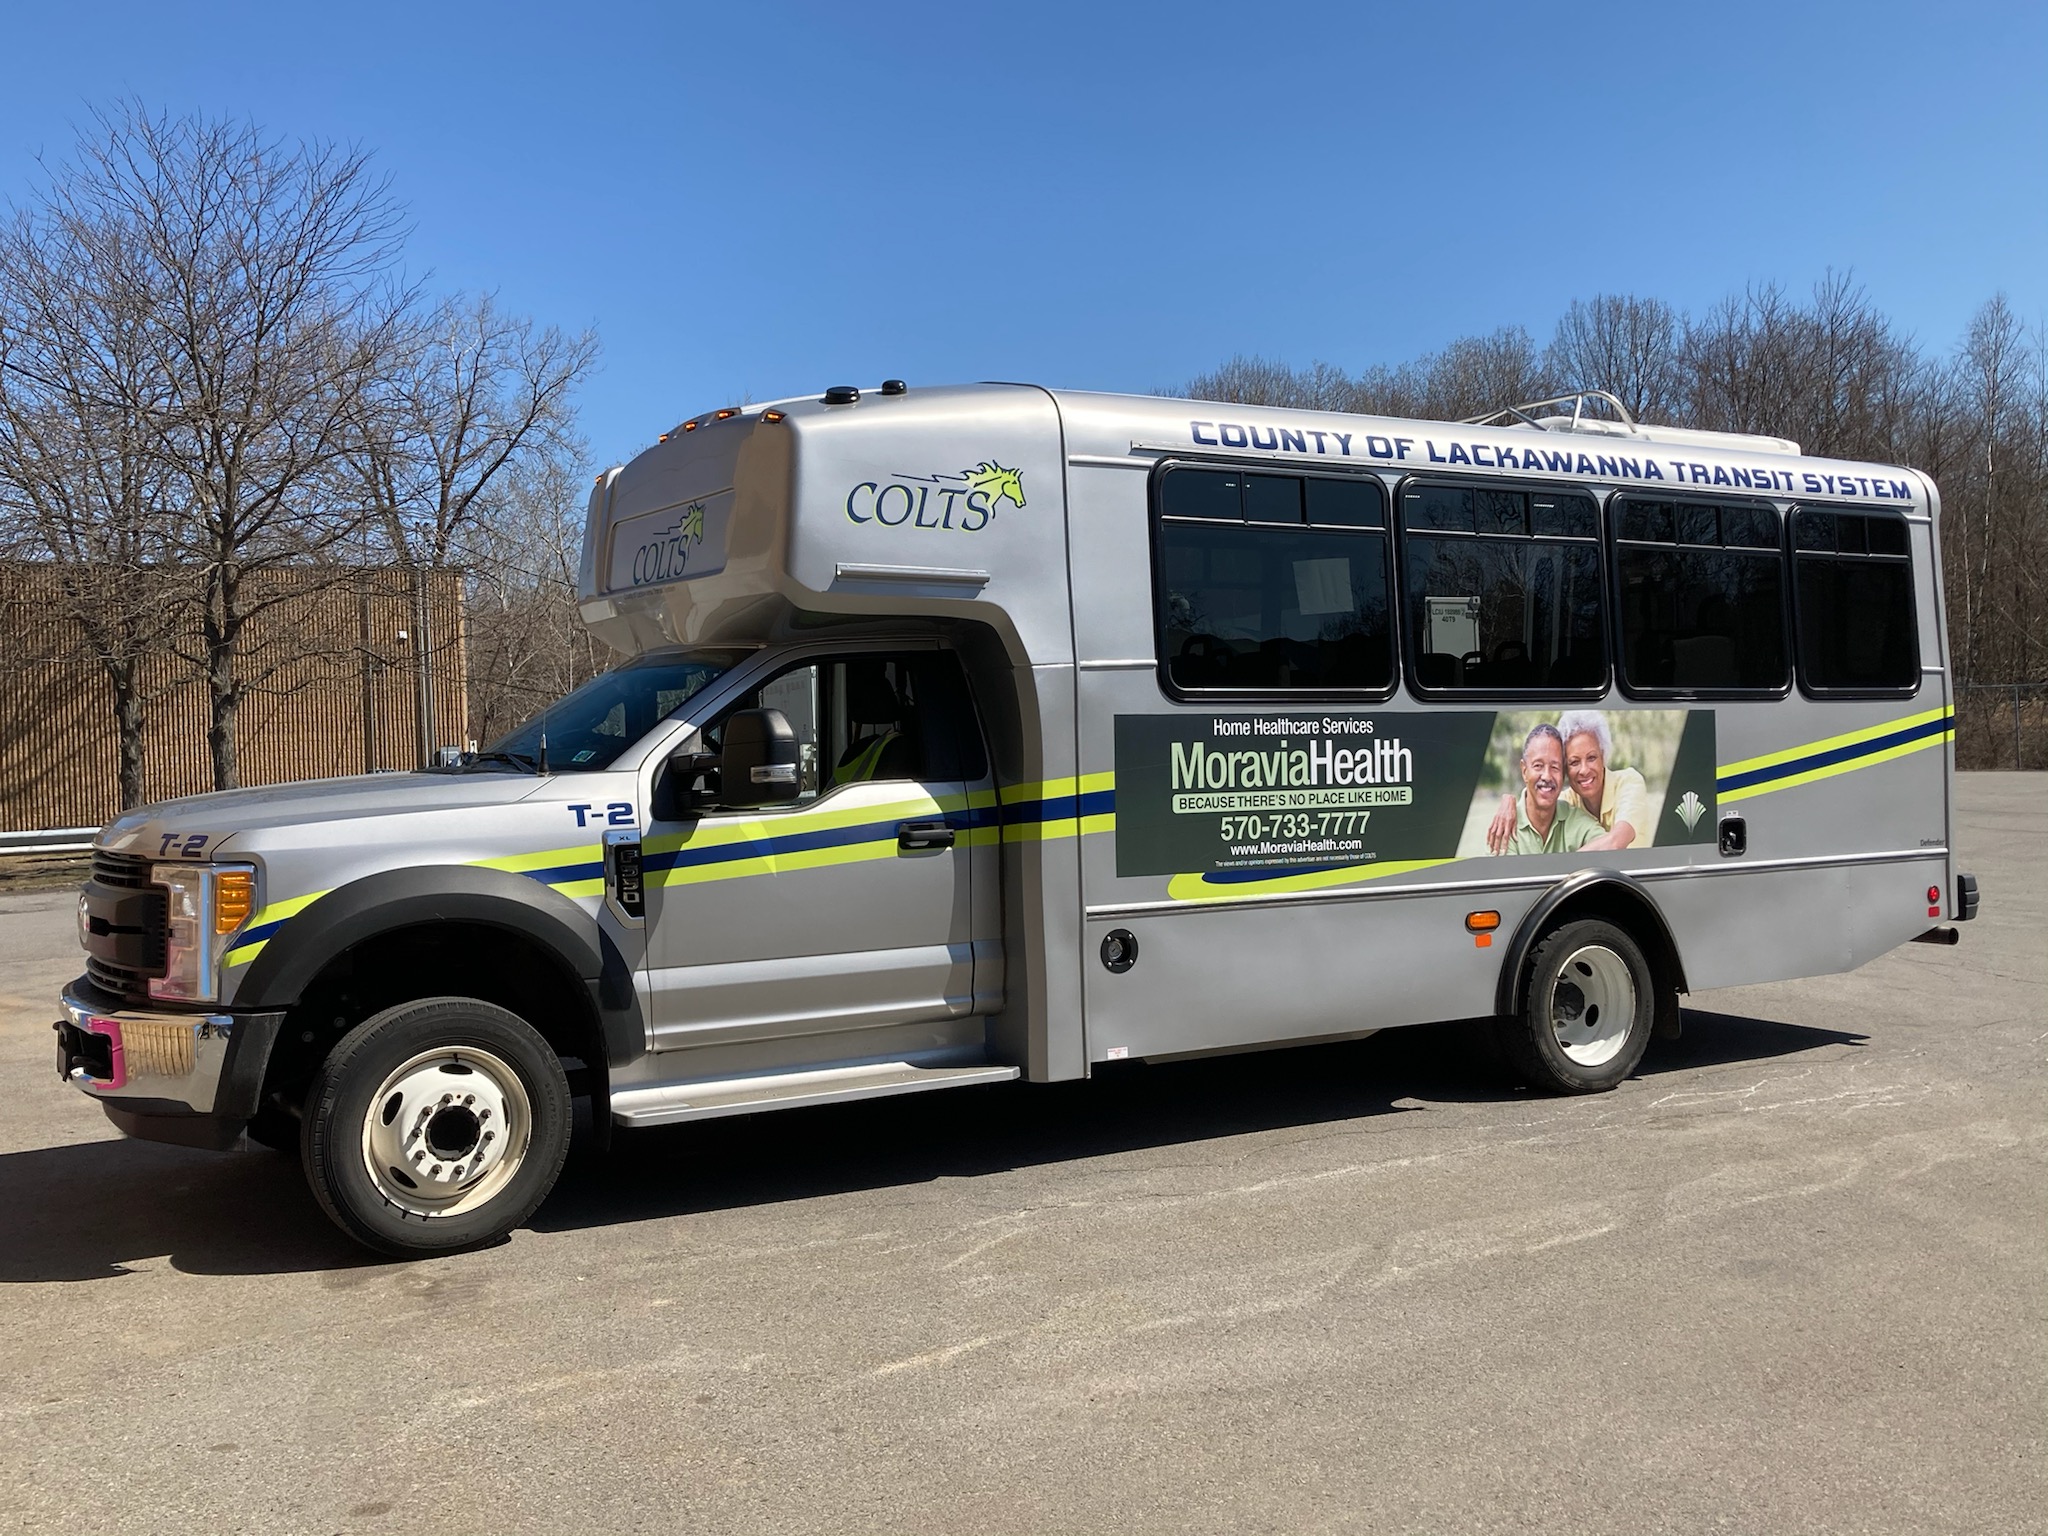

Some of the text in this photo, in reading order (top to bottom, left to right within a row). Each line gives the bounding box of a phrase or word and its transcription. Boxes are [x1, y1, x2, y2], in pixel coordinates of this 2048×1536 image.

[1190, 420, 1912, 499] COUNTY OF LACKAWANNA TRANSIT SYSTEM
[845, 481, 992, 533] COLTS
[633, 534, 688, 585] COLTS
[1213, 717, 1374, 736] Home Healthcare Services
[1171, 738, 1412, 789] MoraviaHealth
[1179, 790, 1406, 809] BECAUSE THERE'S NO PLACE LIKE HOME
[567, 803, 635, 827] T-2
[1220, 811, 1370, 841] 570-733-7777
[159, 833, 209, 857] T-2
[1230, 839, 1362, 856] www.MoraviaHealth.com
